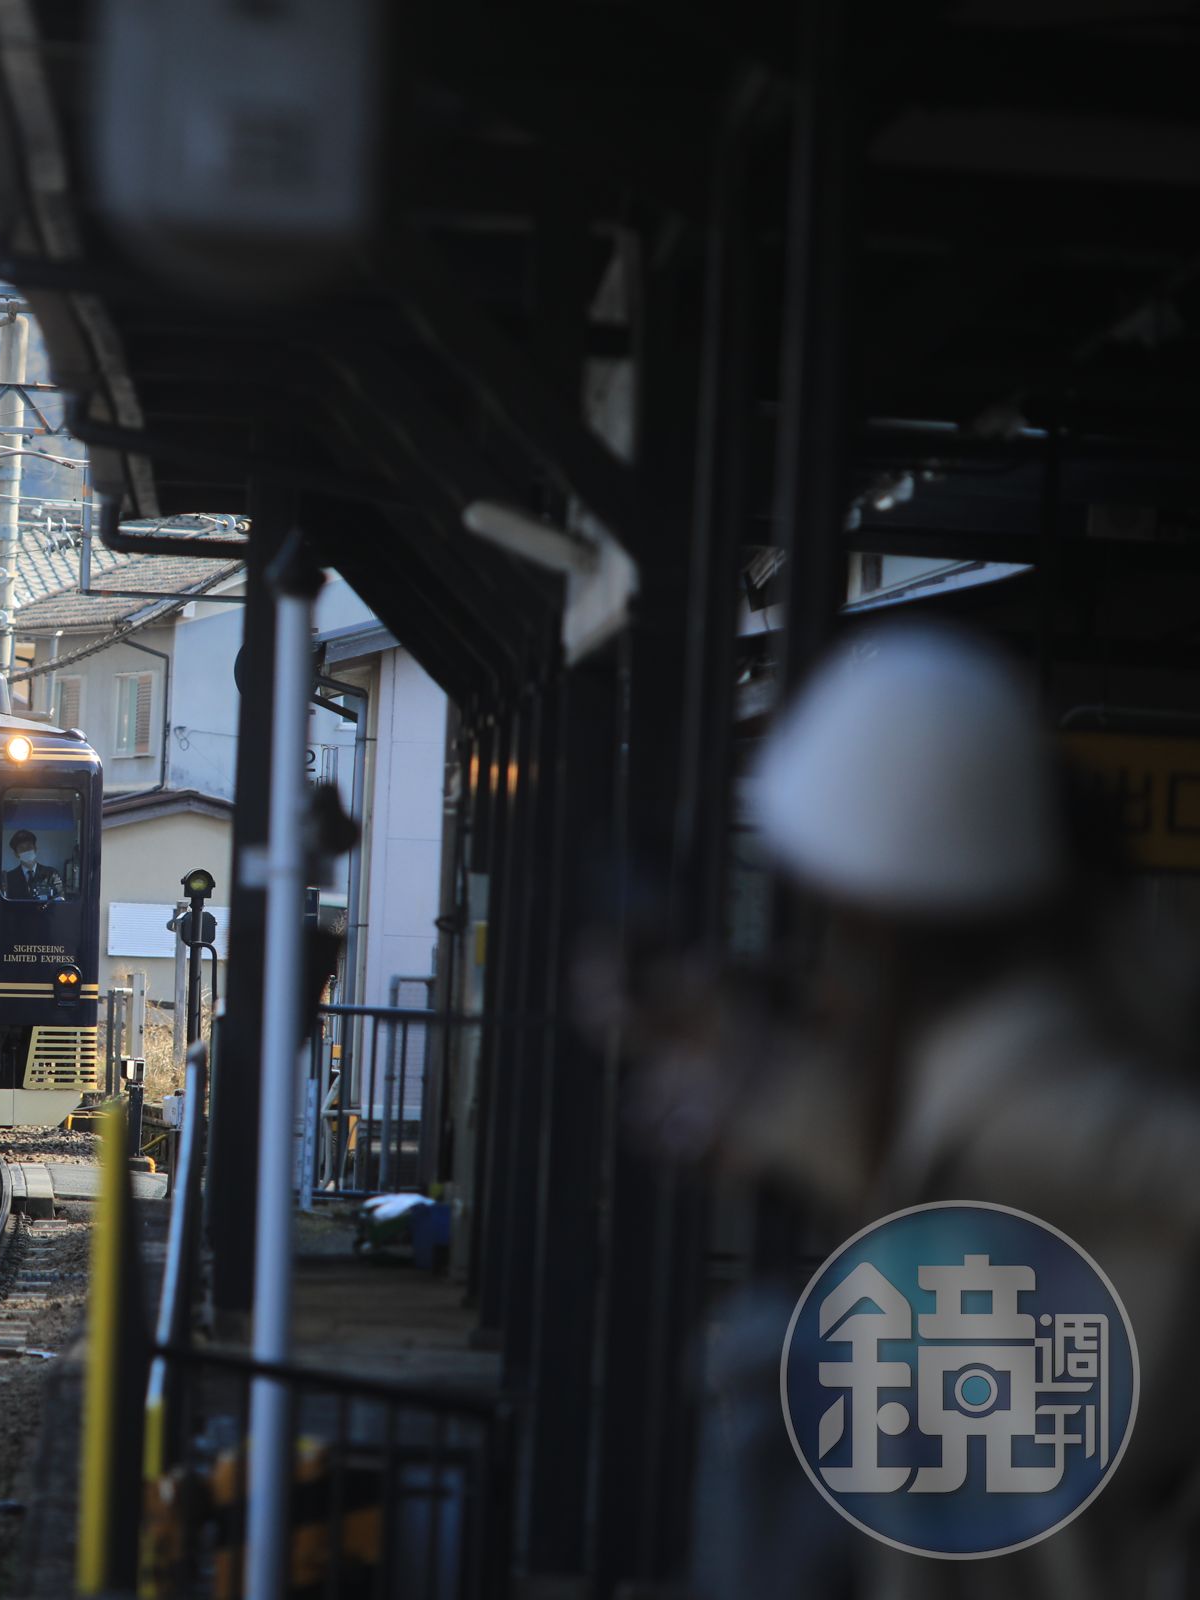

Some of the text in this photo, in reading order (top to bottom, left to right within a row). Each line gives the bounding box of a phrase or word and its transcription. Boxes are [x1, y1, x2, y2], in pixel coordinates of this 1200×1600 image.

[13, 944, 65, 954] SIGHTSEEING
[3, 953, 75, 964] LIMITED EXPRESS
